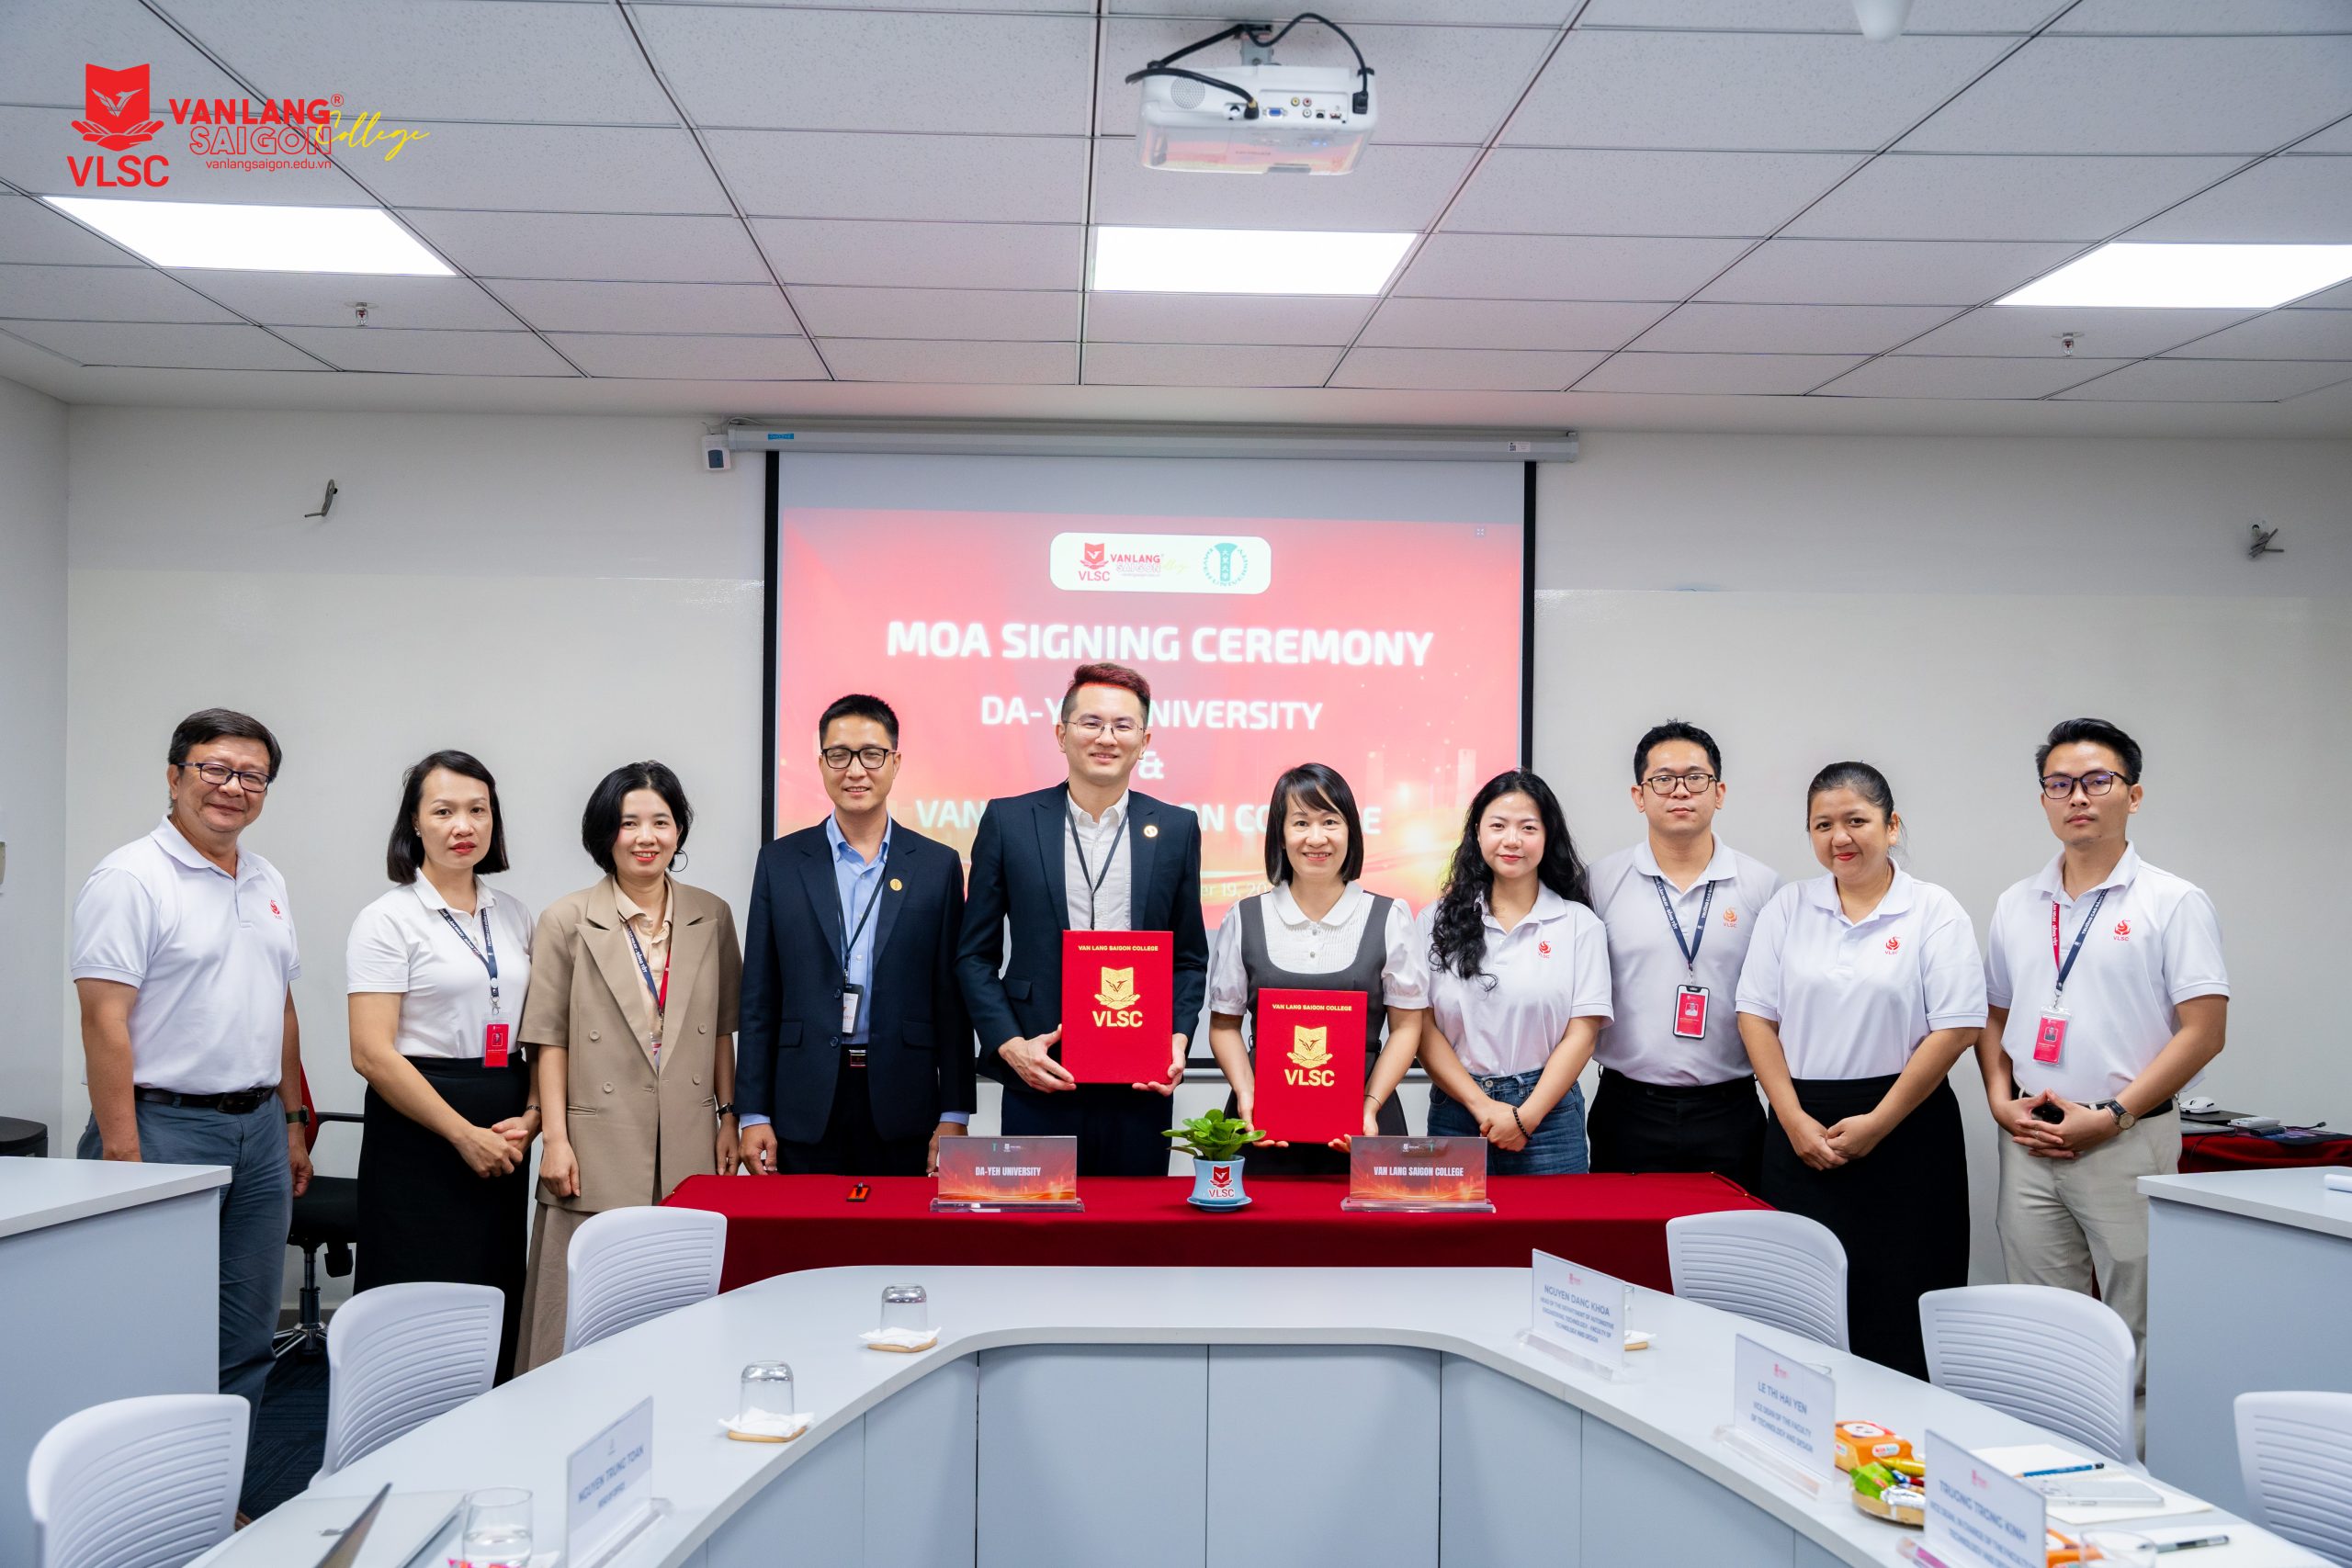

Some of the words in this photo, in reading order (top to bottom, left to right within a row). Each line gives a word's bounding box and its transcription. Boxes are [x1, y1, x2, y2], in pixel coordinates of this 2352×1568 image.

[1079, 570, 1110, 581] VLSC
[887, 621, 991, 658] MOA
[1001, 624, 1180, 661] SIGNING
[1191, 626, 1434, 666] CEREMONY
[1148, 699, 1323, 729] NIVERSITY
[1137, 750, 1165, 780] &
[916, 799, 986, 829] VAN
[1092, 1010, 1143, 1027] VLSC
[1284, 1069, 1335, 1087] VLSC
[975, 1167, 1001, 1177] DA-YEH
[1002, 1167, 1041, 1177] UNIVERSITY
[1374, 1167, 1387, 1176] VAN
[1389, 1167, 1407, 1176] LANG
[1408, 1168, 1433, 1177] SAIGON
[1435, 1168, 1464, 1177] COLLEGE
[1208, 1189, 1235, 1198] VLSC
[1591, 1302, 1610, 1315] KHOA
[1758, 1381, 1765, 1393] LE
[1768, 1385, 1777, 1399] THI
[1779, 1392, 1791, 1406] HAI
[1793, 1398, 1806, 1414] YEN
